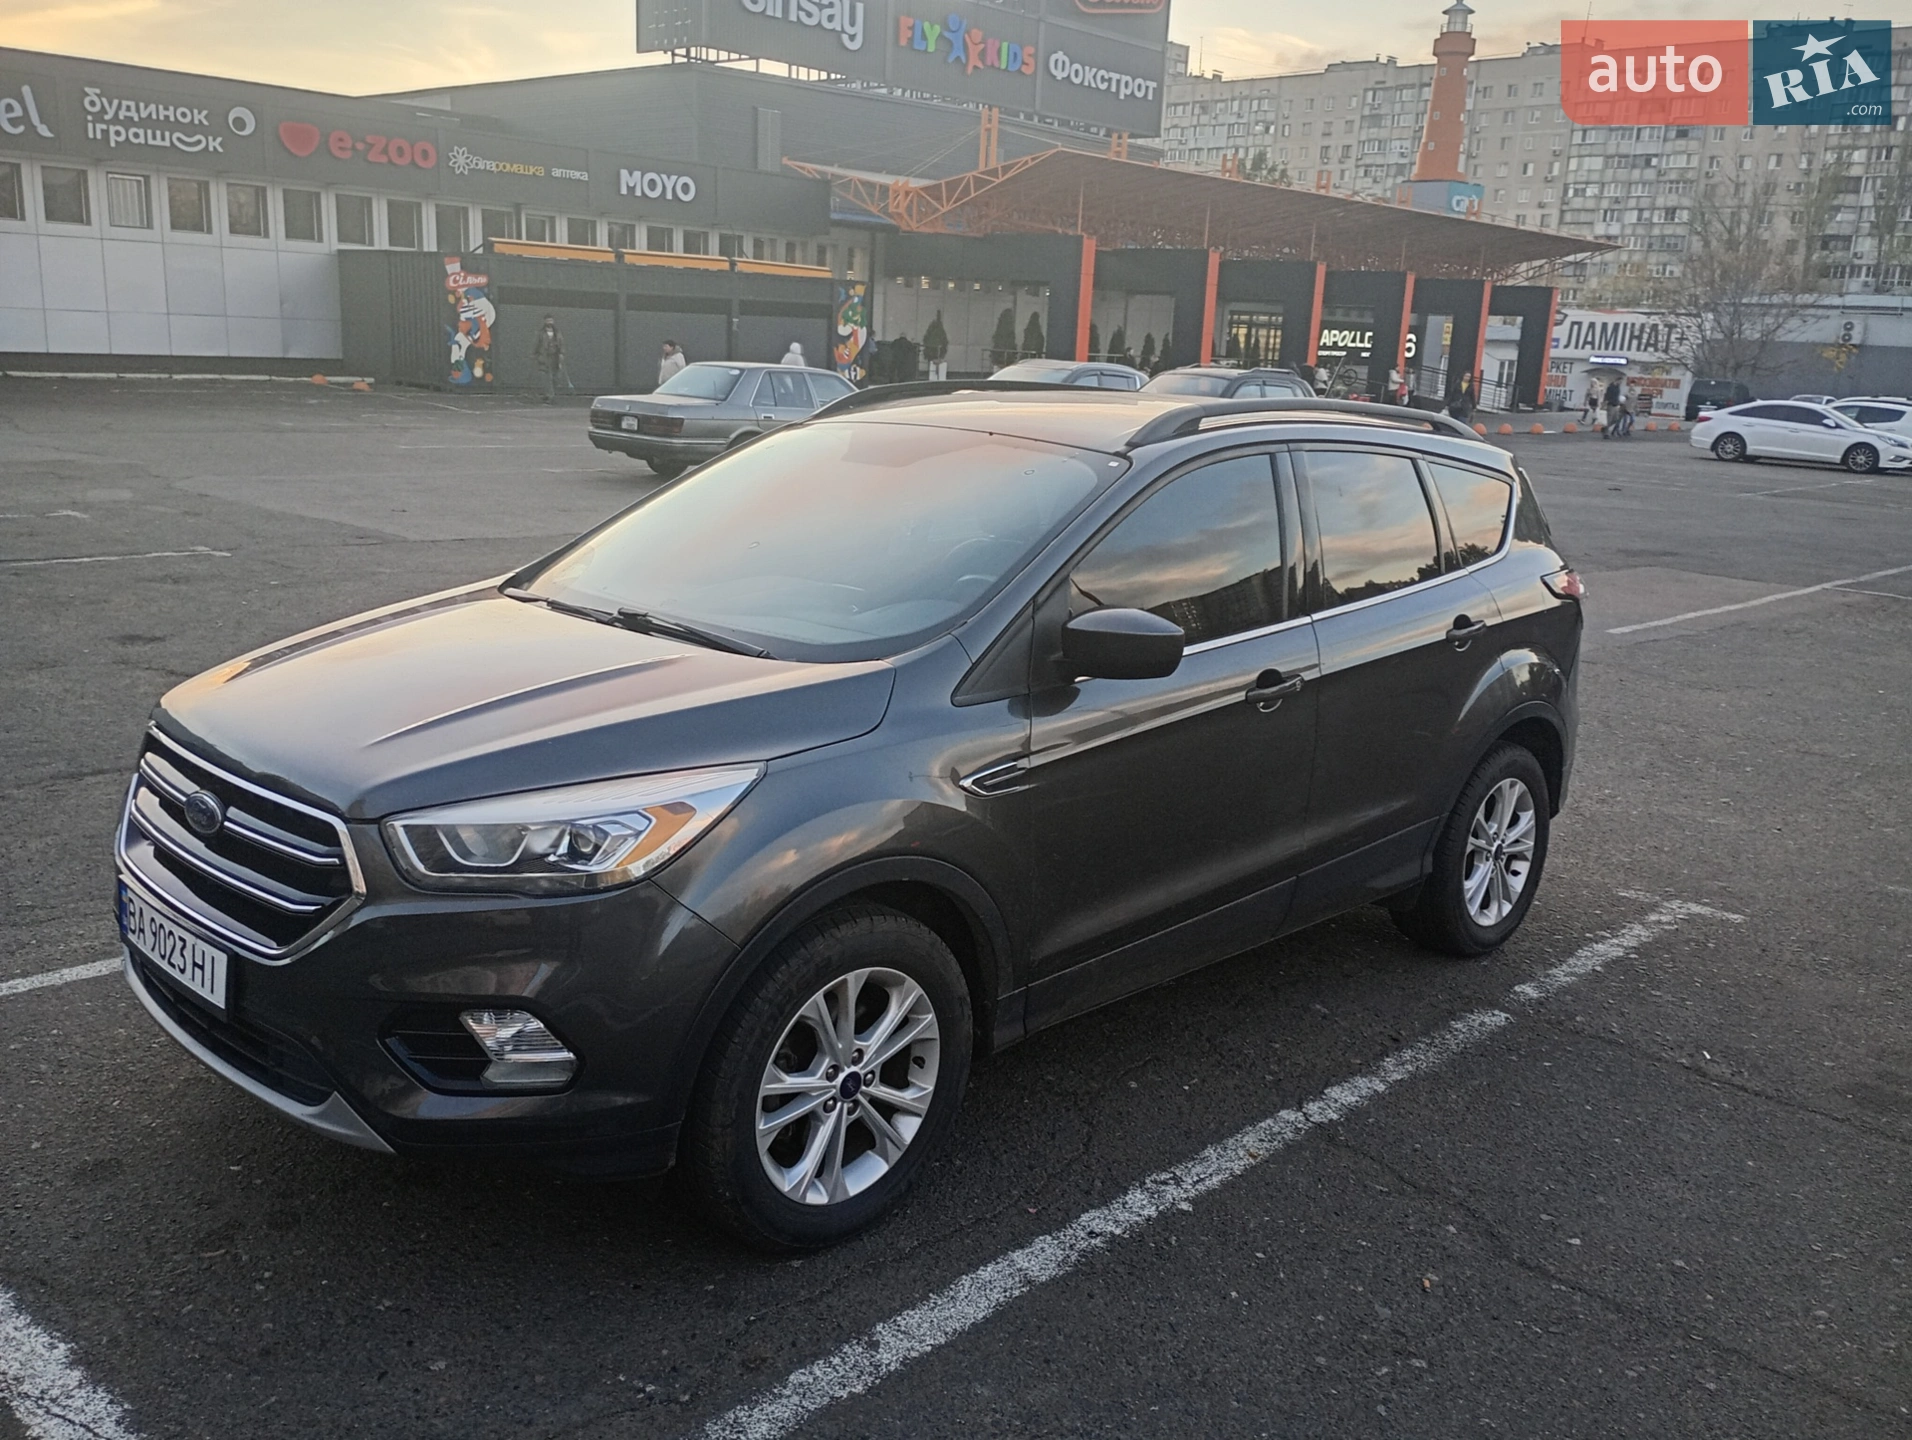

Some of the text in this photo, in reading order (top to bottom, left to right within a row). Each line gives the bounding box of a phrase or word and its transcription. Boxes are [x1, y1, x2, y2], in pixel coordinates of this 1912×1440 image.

[900, 16, 1036, 75] FLY KIDS
[1048, 49, 1157, 101] Фокстрот
[83, 86, 210, 126] будинок
[551, 167, 589, 181] аптека
[620, 168, 697, 202] MOYO
[1547, 361, 1574, 374] РКЕТ
[128, 896, 215, 995] BA 9023 HI
